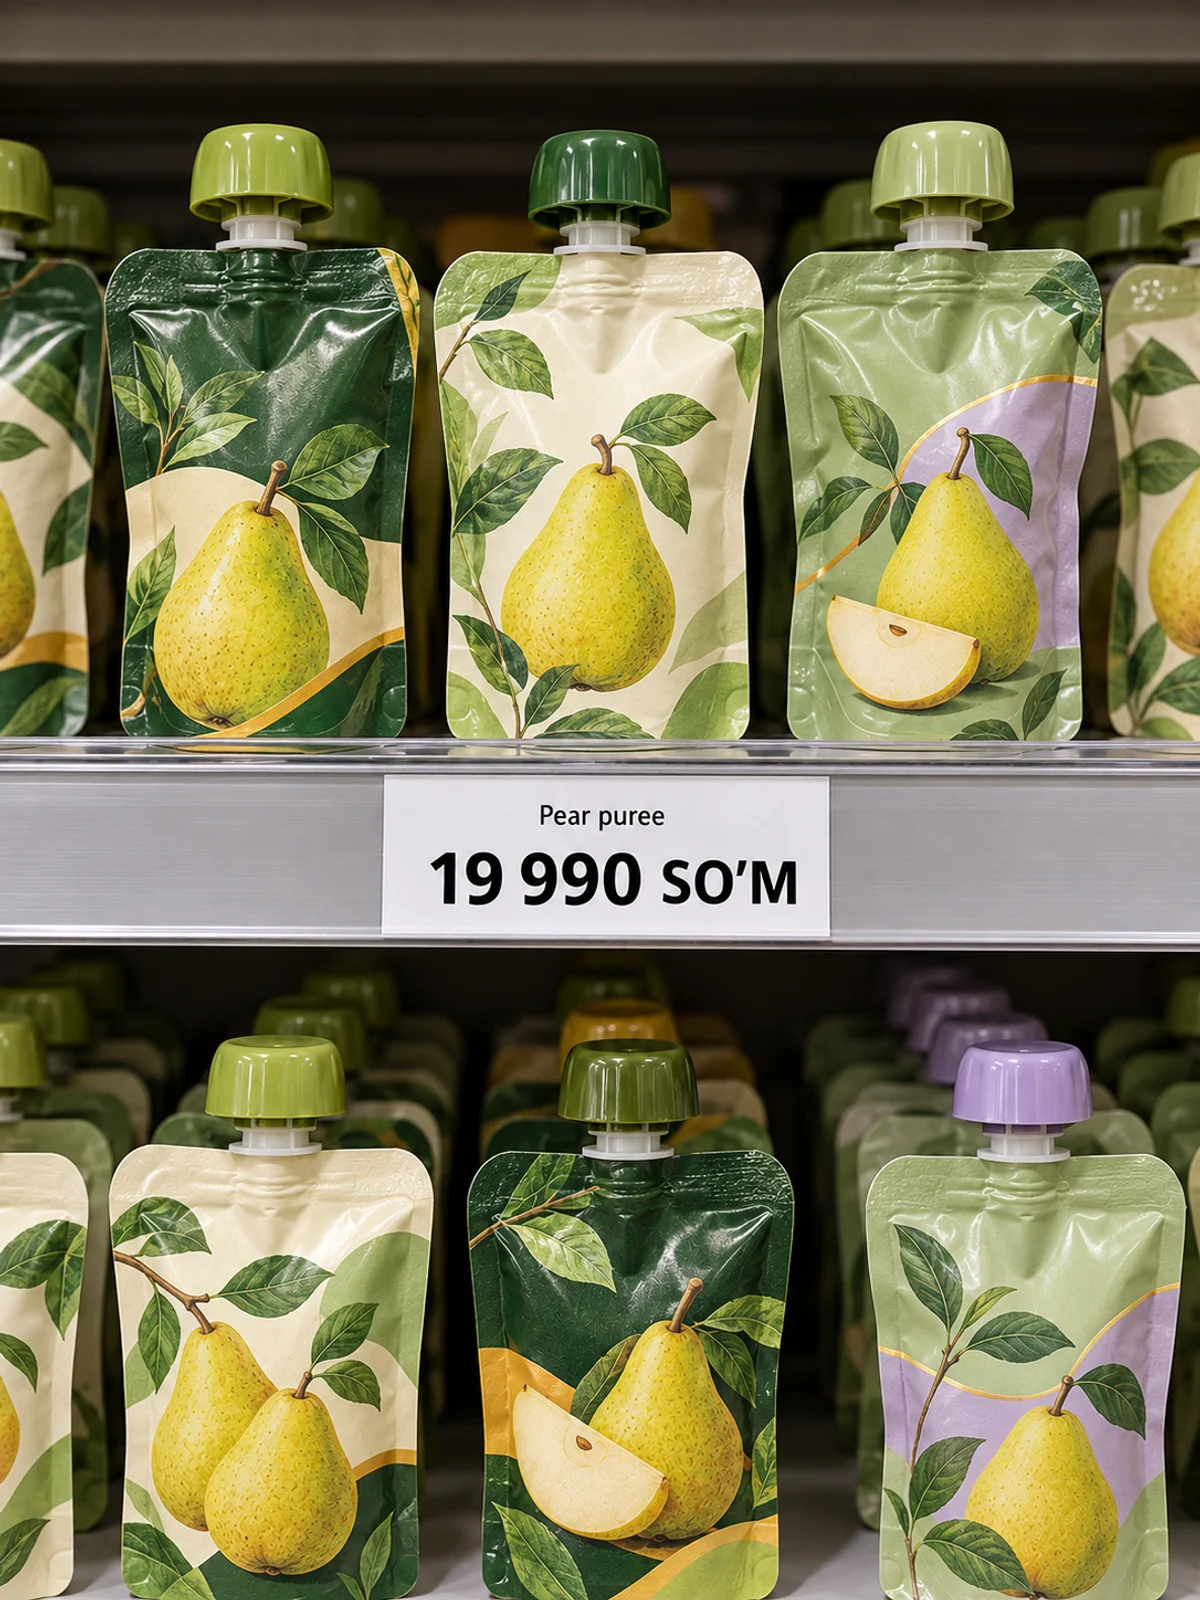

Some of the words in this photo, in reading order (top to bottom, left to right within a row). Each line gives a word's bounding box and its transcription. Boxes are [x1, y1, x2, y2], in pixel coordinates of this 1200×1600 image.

[540, 804, 591, 826] Pear
[599, 809, 665, 832] puree
[430, 852, 503, 906] 19
[520, 852, 642, 906] 990
[662, 859, 797, 905] SO’M
